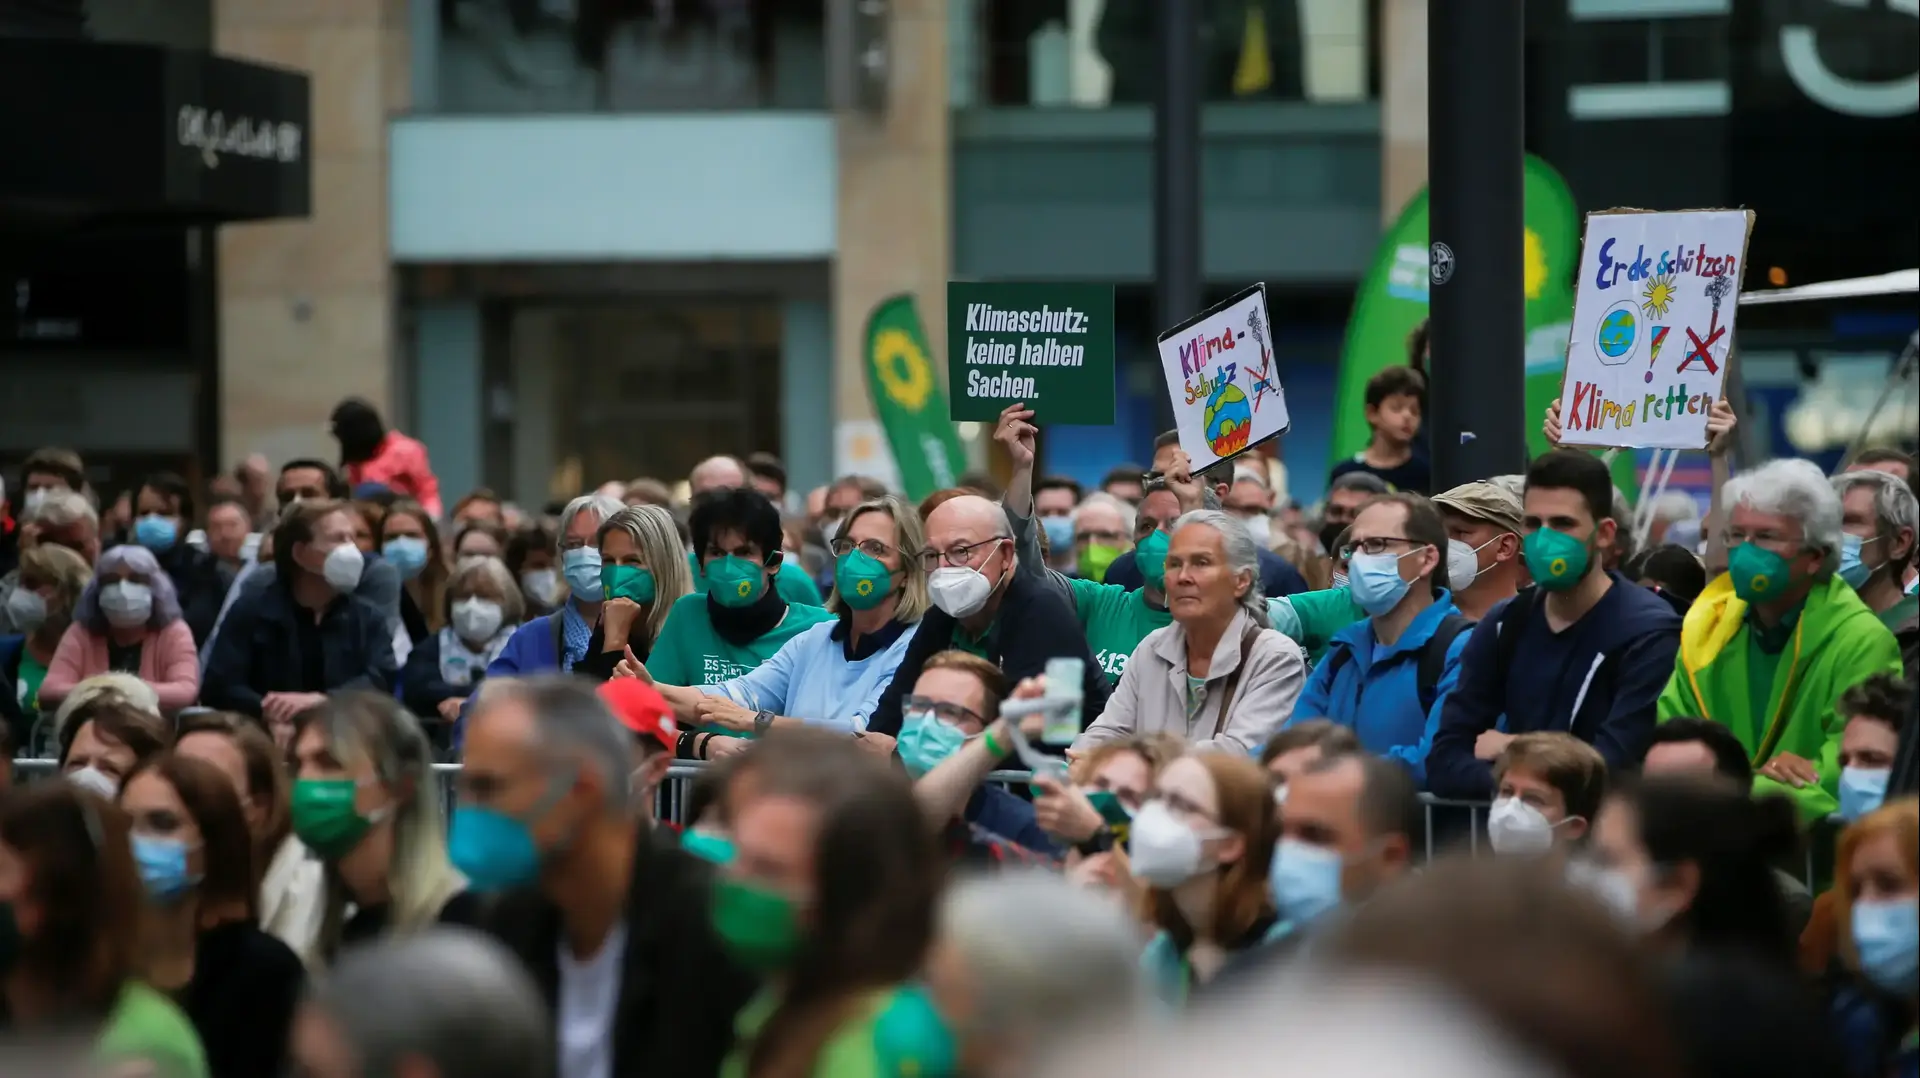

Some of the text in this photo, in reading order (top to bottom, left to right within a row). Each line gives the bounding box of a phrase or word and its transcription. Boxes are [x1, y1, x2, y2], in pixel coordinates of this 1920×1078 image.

[1596, 238, 1652, 290] Erde
[965, 303, 1089, 333] Klimaschutz:
[965, 336, 1085, 367] keine halben
[1178, 326, 1246, 380] Klima-
[966, 368, 1040, 399] Sachen.
[1566, 381, 1713, 432] Klima retten
[703, 659, 719, 671] ES
